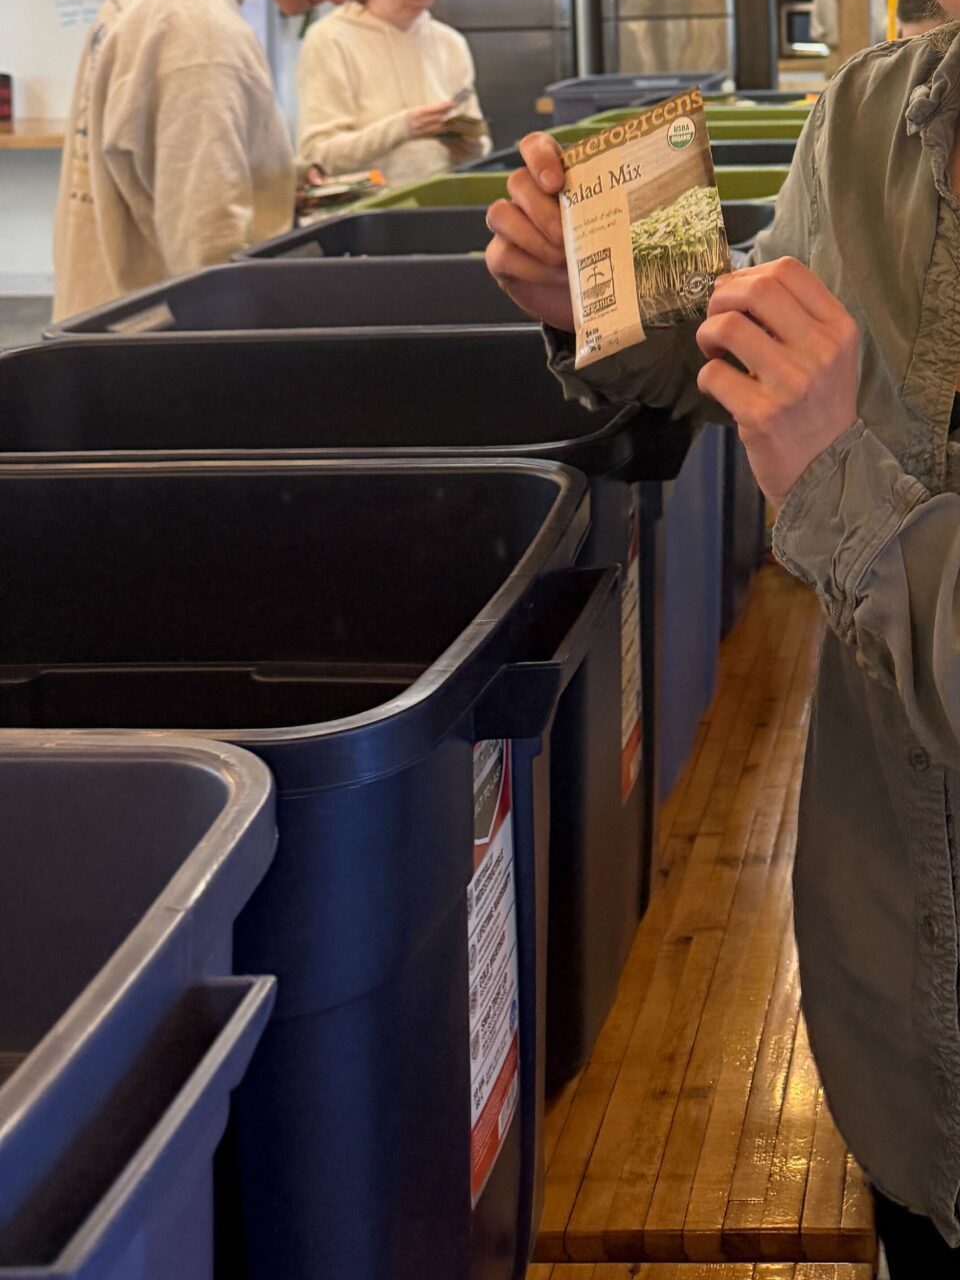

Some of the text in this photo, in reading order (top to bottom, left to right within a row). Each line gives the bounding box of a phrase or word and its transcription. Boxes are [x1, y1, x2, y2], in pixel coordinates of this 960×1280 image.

[673, 123, 690, 133] USDA
[562, 163, 642, 209] Salad Mix
